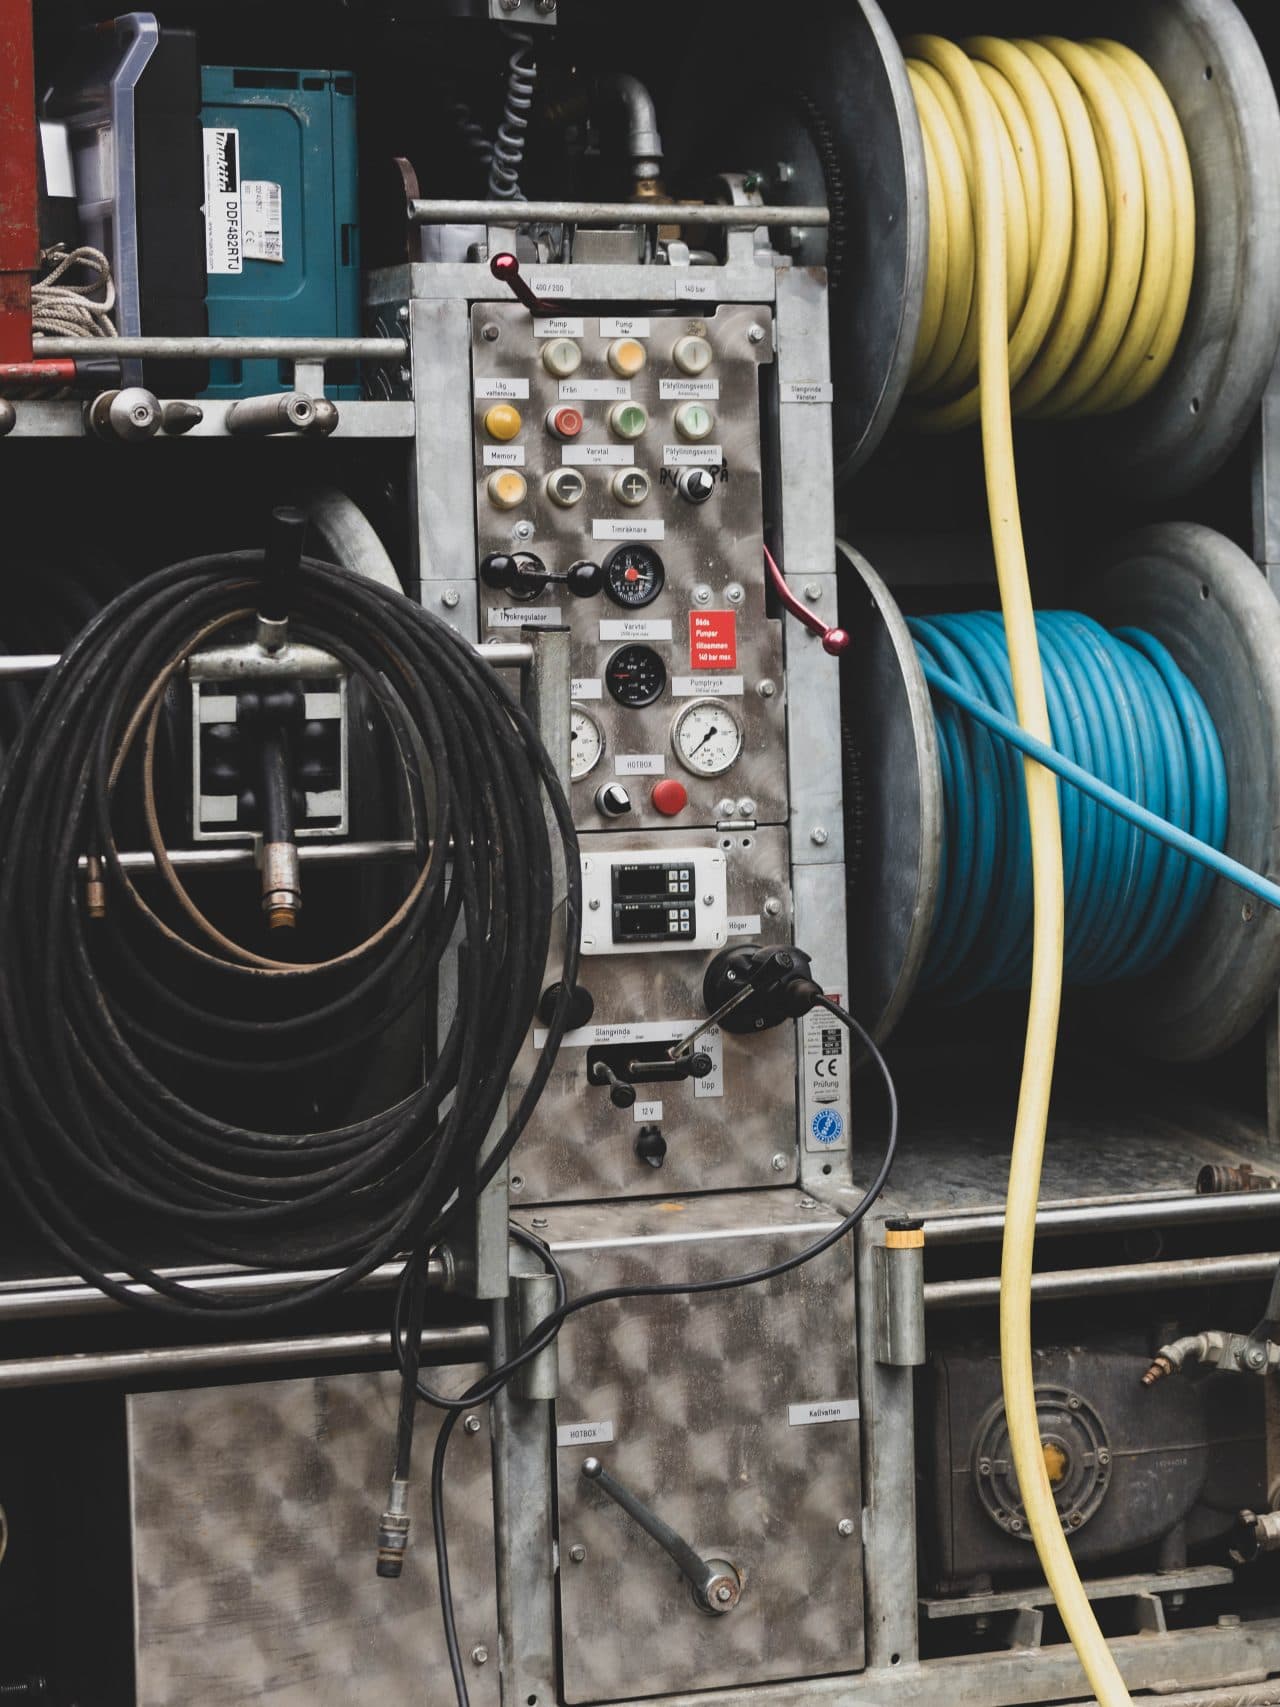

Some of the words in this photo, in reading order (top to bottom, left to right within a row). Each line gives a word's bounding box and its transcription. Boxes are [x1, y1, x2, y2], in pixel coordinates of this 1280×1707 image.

[216, 132, 232, 192] makita
[226, 201, 239, 270] DDF482RTJ
[549, 320, 568, 328] Pump
[615, 320, 633, 329] Pump
[491, 452, 517, 460] Memory
[611, 525, 647, 533] Timräknare
[624, 623, 646, 631] Varvtal
[627, 761, 652, 769] HOTBOX
[595, 1027, 631, 1037] Slangvinda
[701, 1045, 713, 1053] Ner
[815, 1058, 838, 1077] CE
[701, 1081, 715, 1090] Upp
[813, 1080, 840, 1088] Prüfung
[642, 1107, 649, 1115] 12
[649, 1107, 654, 1115] V
[569, 1429, 597, 1438] HOTBOX
